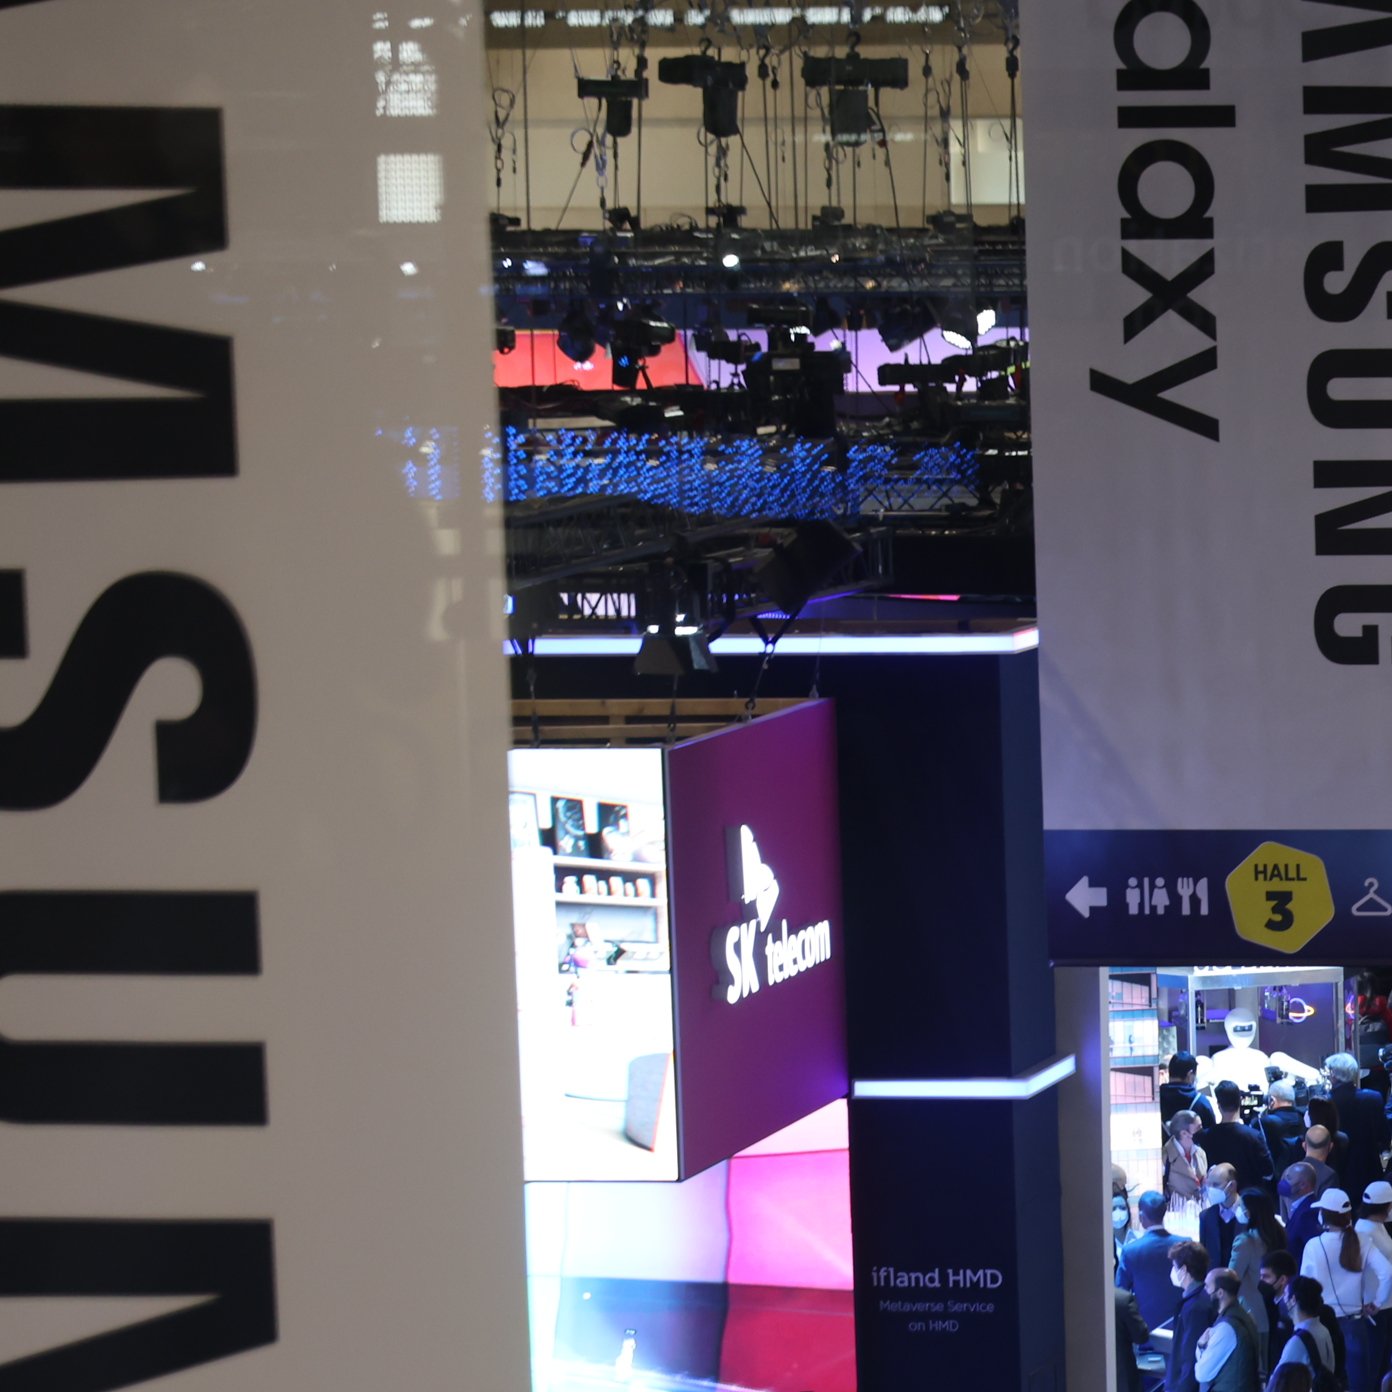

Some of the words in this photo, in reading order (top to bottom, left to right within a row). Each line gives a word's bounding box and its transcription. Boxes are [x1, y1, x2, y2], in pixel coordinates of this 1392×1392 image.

[1254, 863, 1308, 881] HALL
[1264, 891, 1295, 932] 3
[725, 918, 760, 1004] SK
[765, 918, 831, 986] telecom
[946, 1267, 1003, 1289] HMD
[880, 1300, 944, 1313] Metaverse
[947, 1301, 995, 1313] Service
[908, 1321, 926, 1332] on
[929, 1320, 959, 1332] HMD
